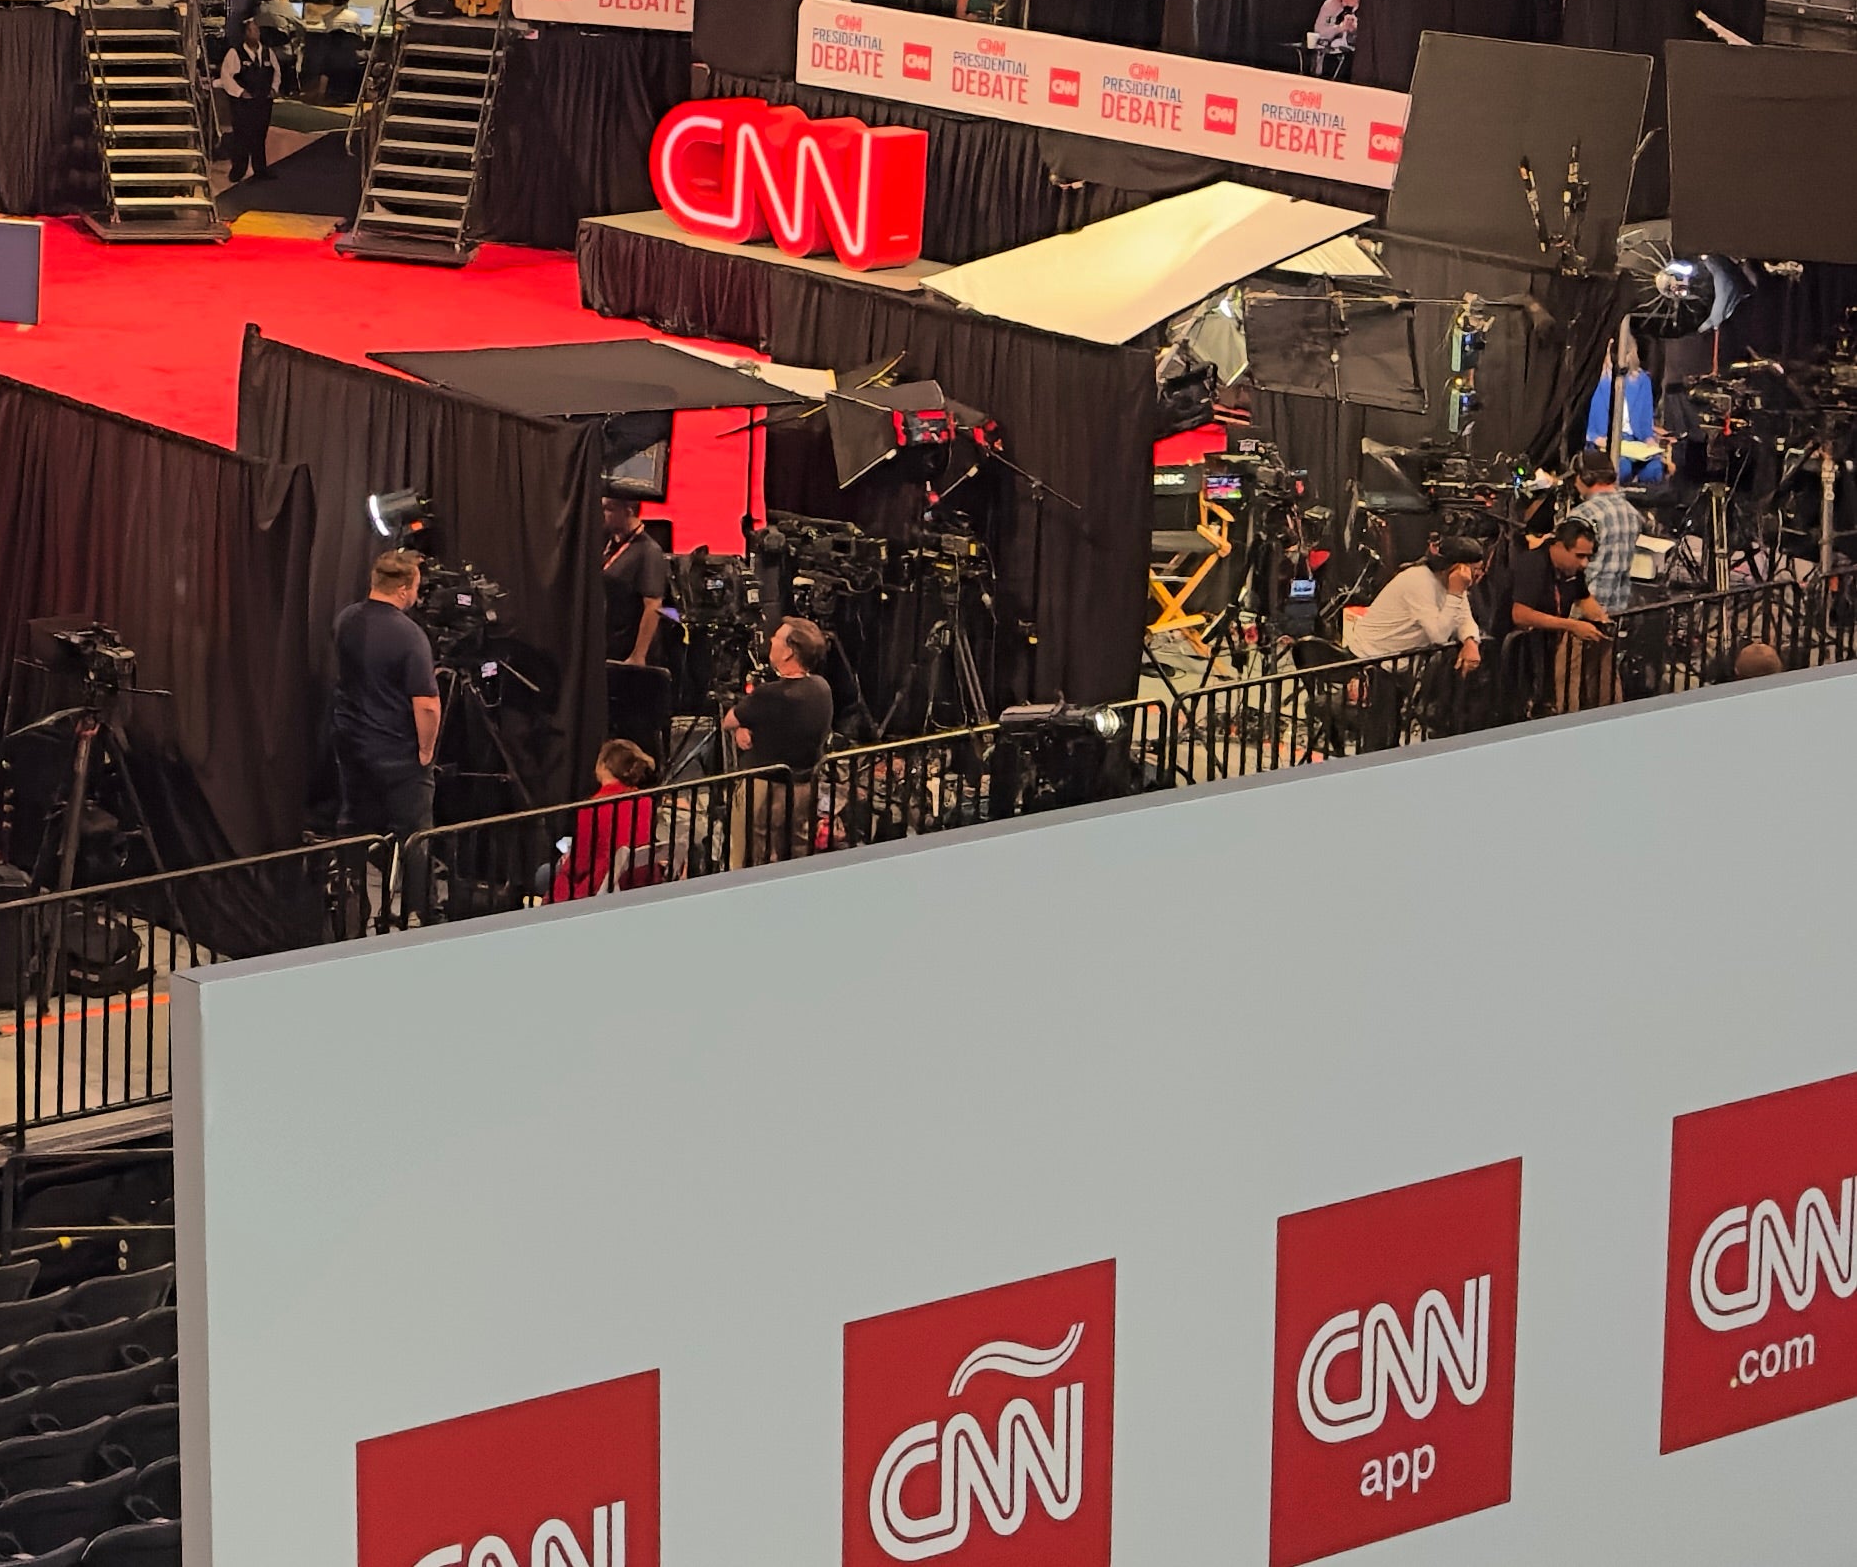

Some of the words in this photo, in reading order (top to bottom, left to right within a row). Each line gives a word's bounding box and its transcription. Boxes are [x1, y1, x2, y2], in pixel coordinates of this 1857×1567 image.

[1101, 92, 1184, 132] DEBATE
[1102, 76, 1184, 103] PRESIDENTIAL
[649, 99, 885, 271] CNN
[1690, 1176, 1857, 1332] CNN
[1297, 1274, 1491, 1444] CNN
[1729, 1333, 1816, 1388] .com
[1360, 1444, 1436, 1501] app
